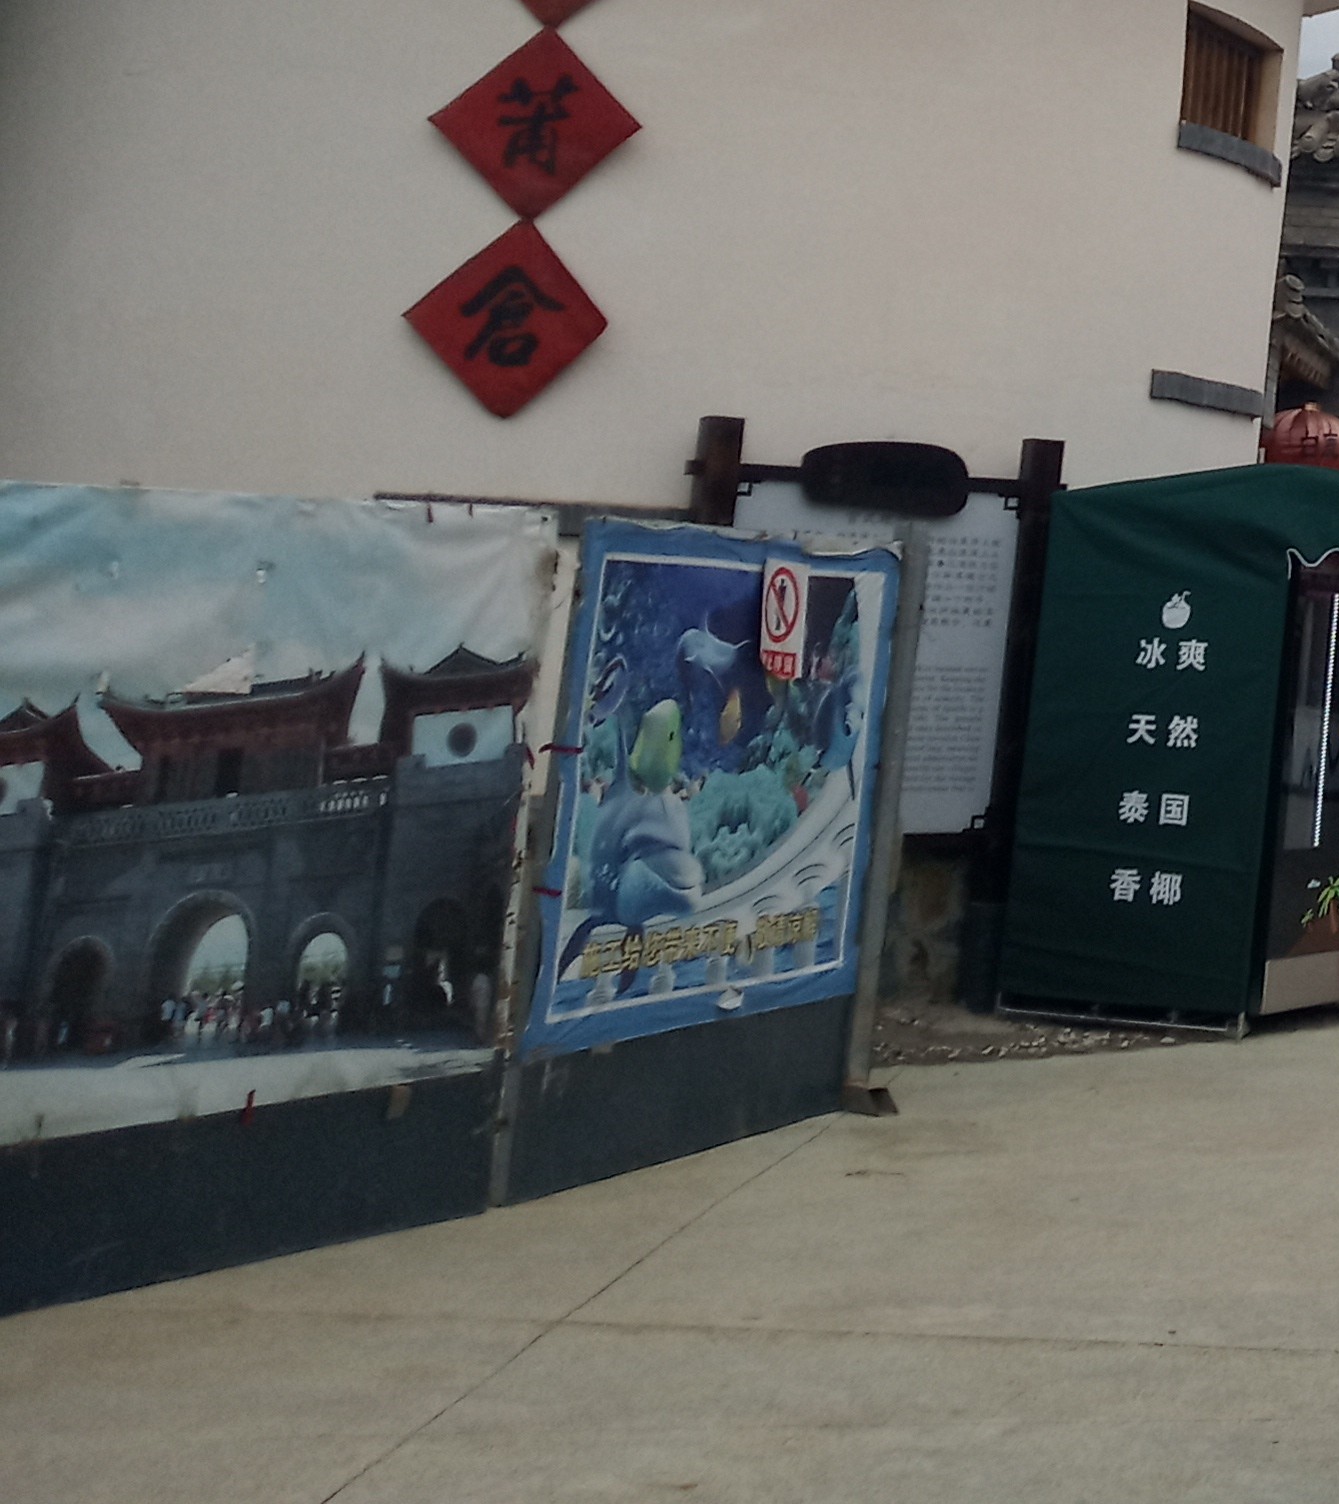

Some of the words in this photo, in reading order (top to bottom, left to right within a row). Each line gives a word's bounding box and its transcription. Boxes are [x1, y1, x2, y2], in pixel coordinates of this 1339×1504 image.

[1135, 637, 1208, 671] 冰爽
[1126, 713, 1199, 748] 天然
[1118, 791, 1190, 826] 泰国
[1110, 867, 1183, 906] 香椰
